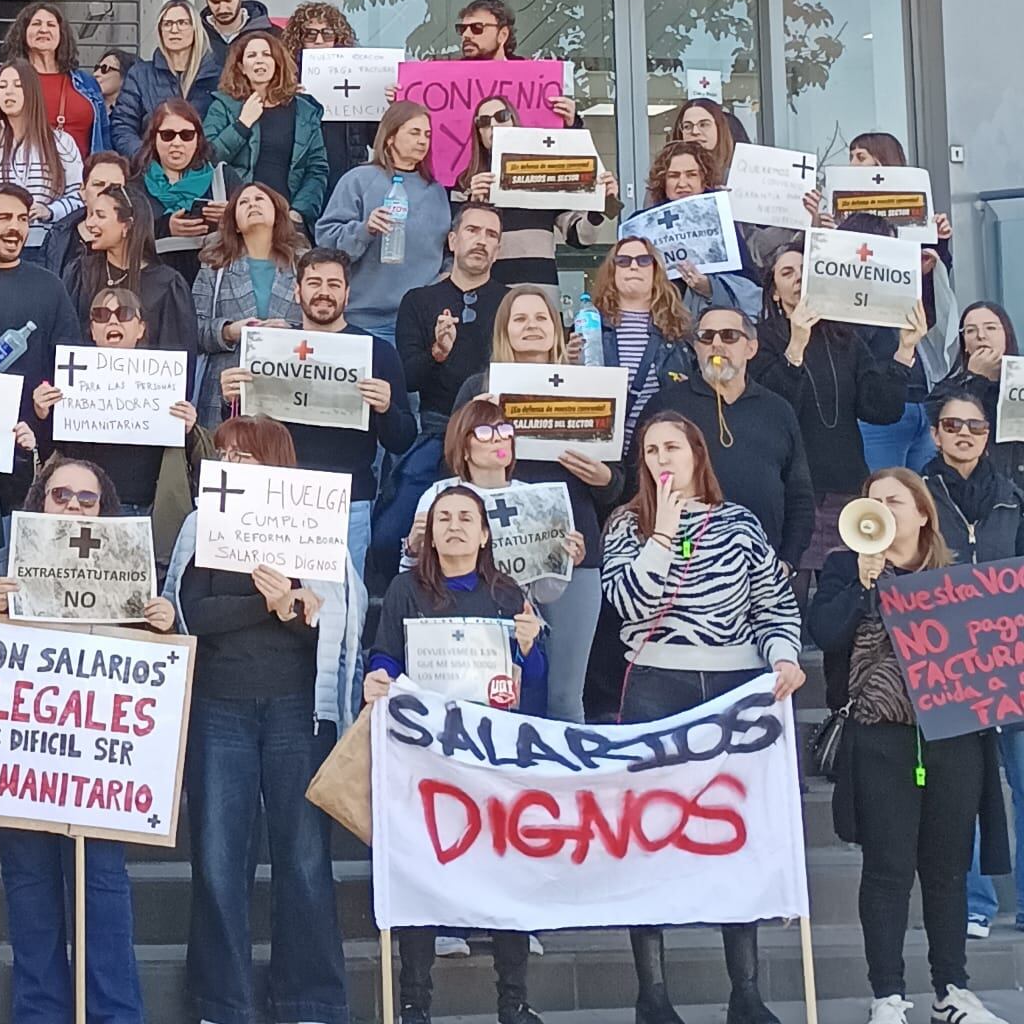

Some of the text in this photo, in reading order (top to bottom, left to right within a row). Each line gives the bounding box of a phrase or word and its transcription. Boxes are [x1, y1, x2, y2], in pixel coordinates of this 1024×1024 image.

[308, 66, 320, 75] NO
[663, 248, 687, 263] NO
[814, 260, 911, 284] CONVENIOS
[853, 292, 868, 307] SI
[97, 352, 184, 377] DIGNIDAD
[250, 360, 358, 383] CONVENIOS
[79, 380, 176, 392] PARA LAS PERSONAS
[62, 397, 160, 411] TRABAJADORAS
[293, 391, 308, 407] SI
[64, 418, 150, 431] HUMANITARIAS
[513, 419, 553, 430] SALARIOS
[567, 419, 594, 429] SECTOR
[267, 478, 347, 513] HUELGA
[241, 511, 318, 529] CUMPLID
[208, 529, 345, 545] LA REFORMA LABORAL
[215, 546, 337, 571] SALARIOS DIGNOS
[497, 557, 526, 575] NO
[17, 566, 147, 582] EXTRAESTATUTARIOS
[64, 591, 96, 609] NO
[880, 574, 984, 616] Nuestra
[892, 619, 949, 660] NO
[37, 647, 166, 687] SALARIOS
[917, 679, 983, 711] cuida
[988, 676, 1007, 691] a
[970, 690, 1024, 726] TA
[388, 692, 783, 772] SALARIOS
[10, 728, 81, 758] DIFICIL
[94, 736, 134, 766] SER
[419, 773, 748, 864] DIGNOS
